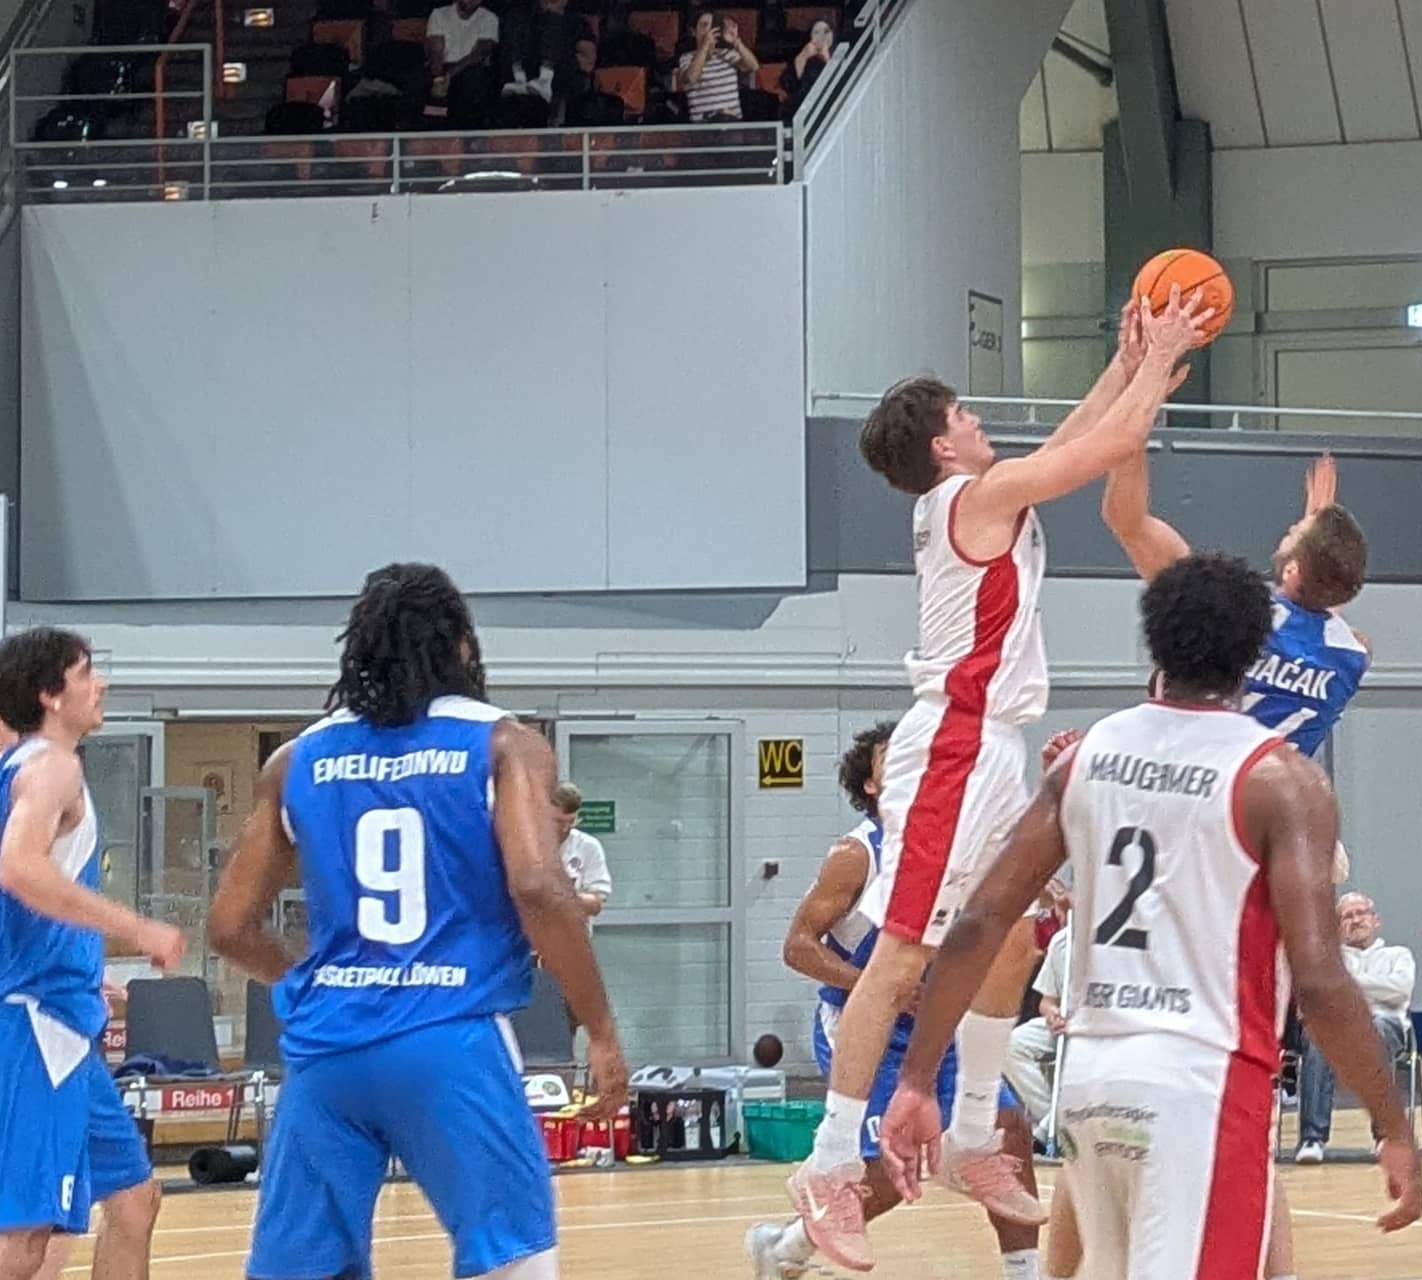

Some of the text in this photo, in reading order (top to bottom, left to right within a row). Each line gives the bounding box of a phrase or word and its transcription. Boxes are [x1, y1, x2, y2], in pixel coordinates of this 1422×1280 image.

[760, 741, 802, 773] WC
[355, 807, 427, 945] 9
[1094, 826, 1156, 950] 2
[171, 1090, 222, 1107] Reihe
